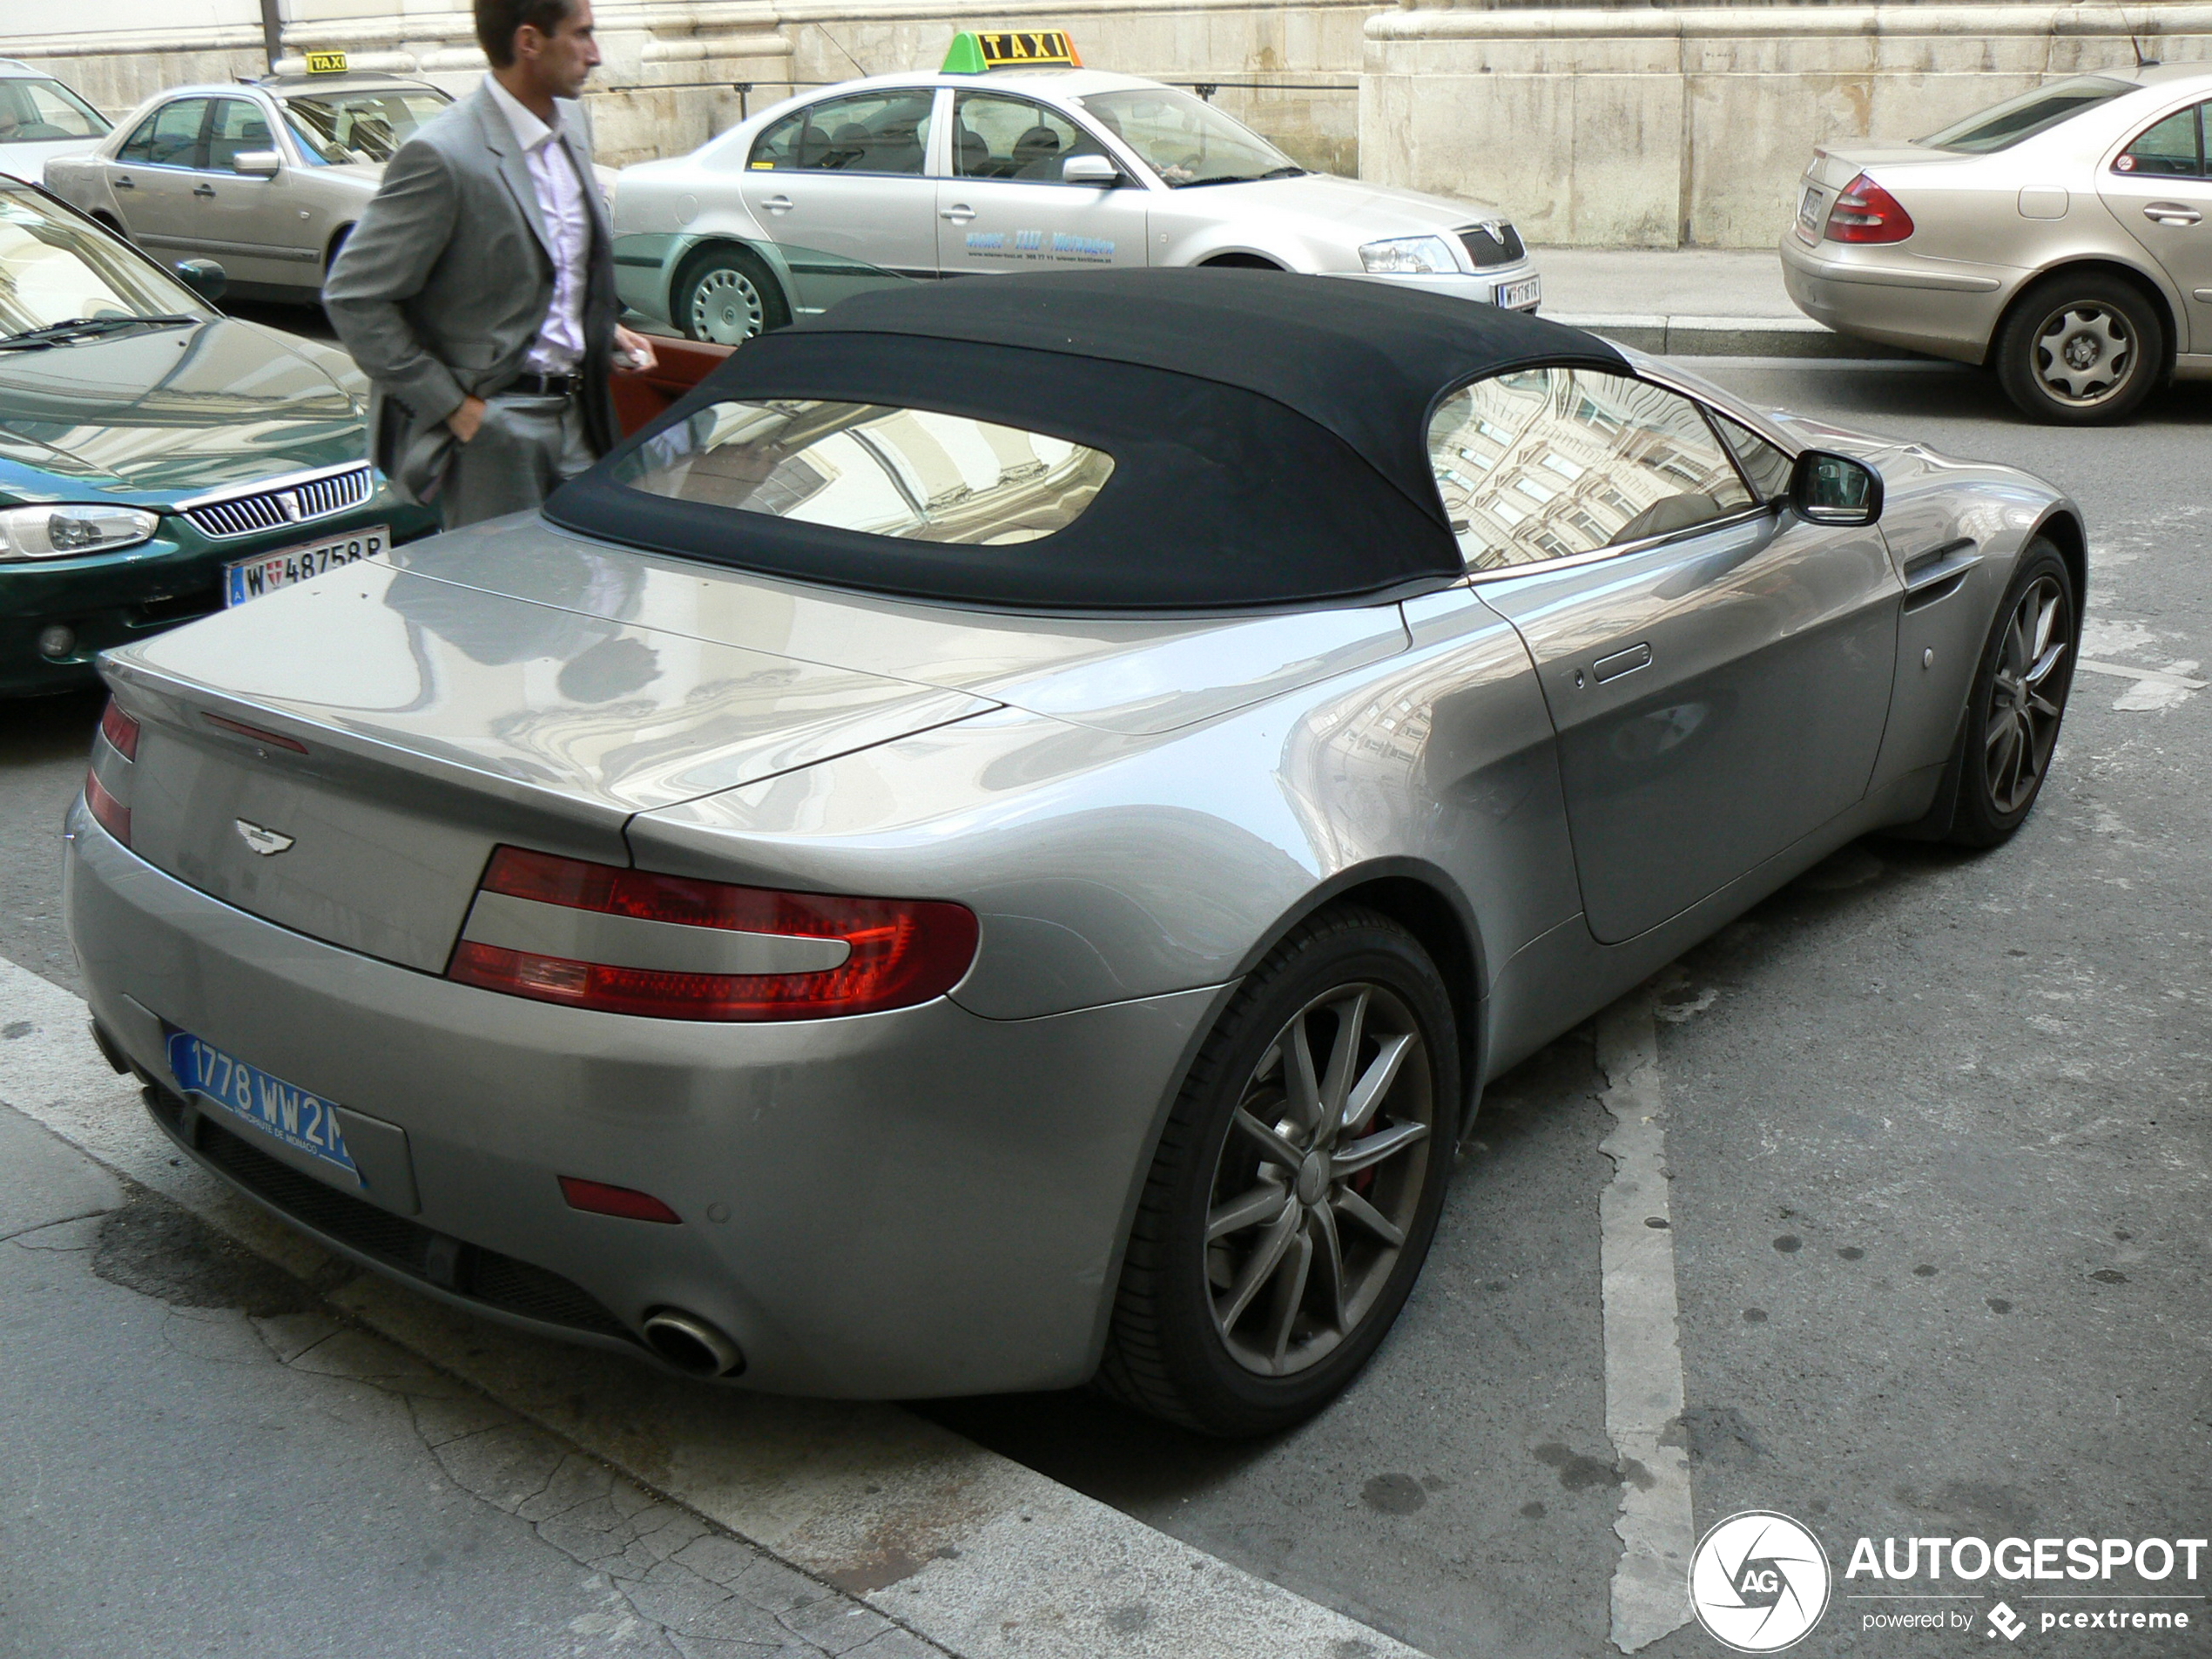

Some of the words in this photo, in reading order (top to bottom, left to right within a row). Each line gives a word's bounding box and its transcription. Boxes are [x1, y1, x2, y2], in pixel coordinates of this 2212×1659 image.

[984, 34, 1063, 58] TAXI
[314, 56, 345, 70] TAXI
[192, 1040, 253, 1110] 1778
